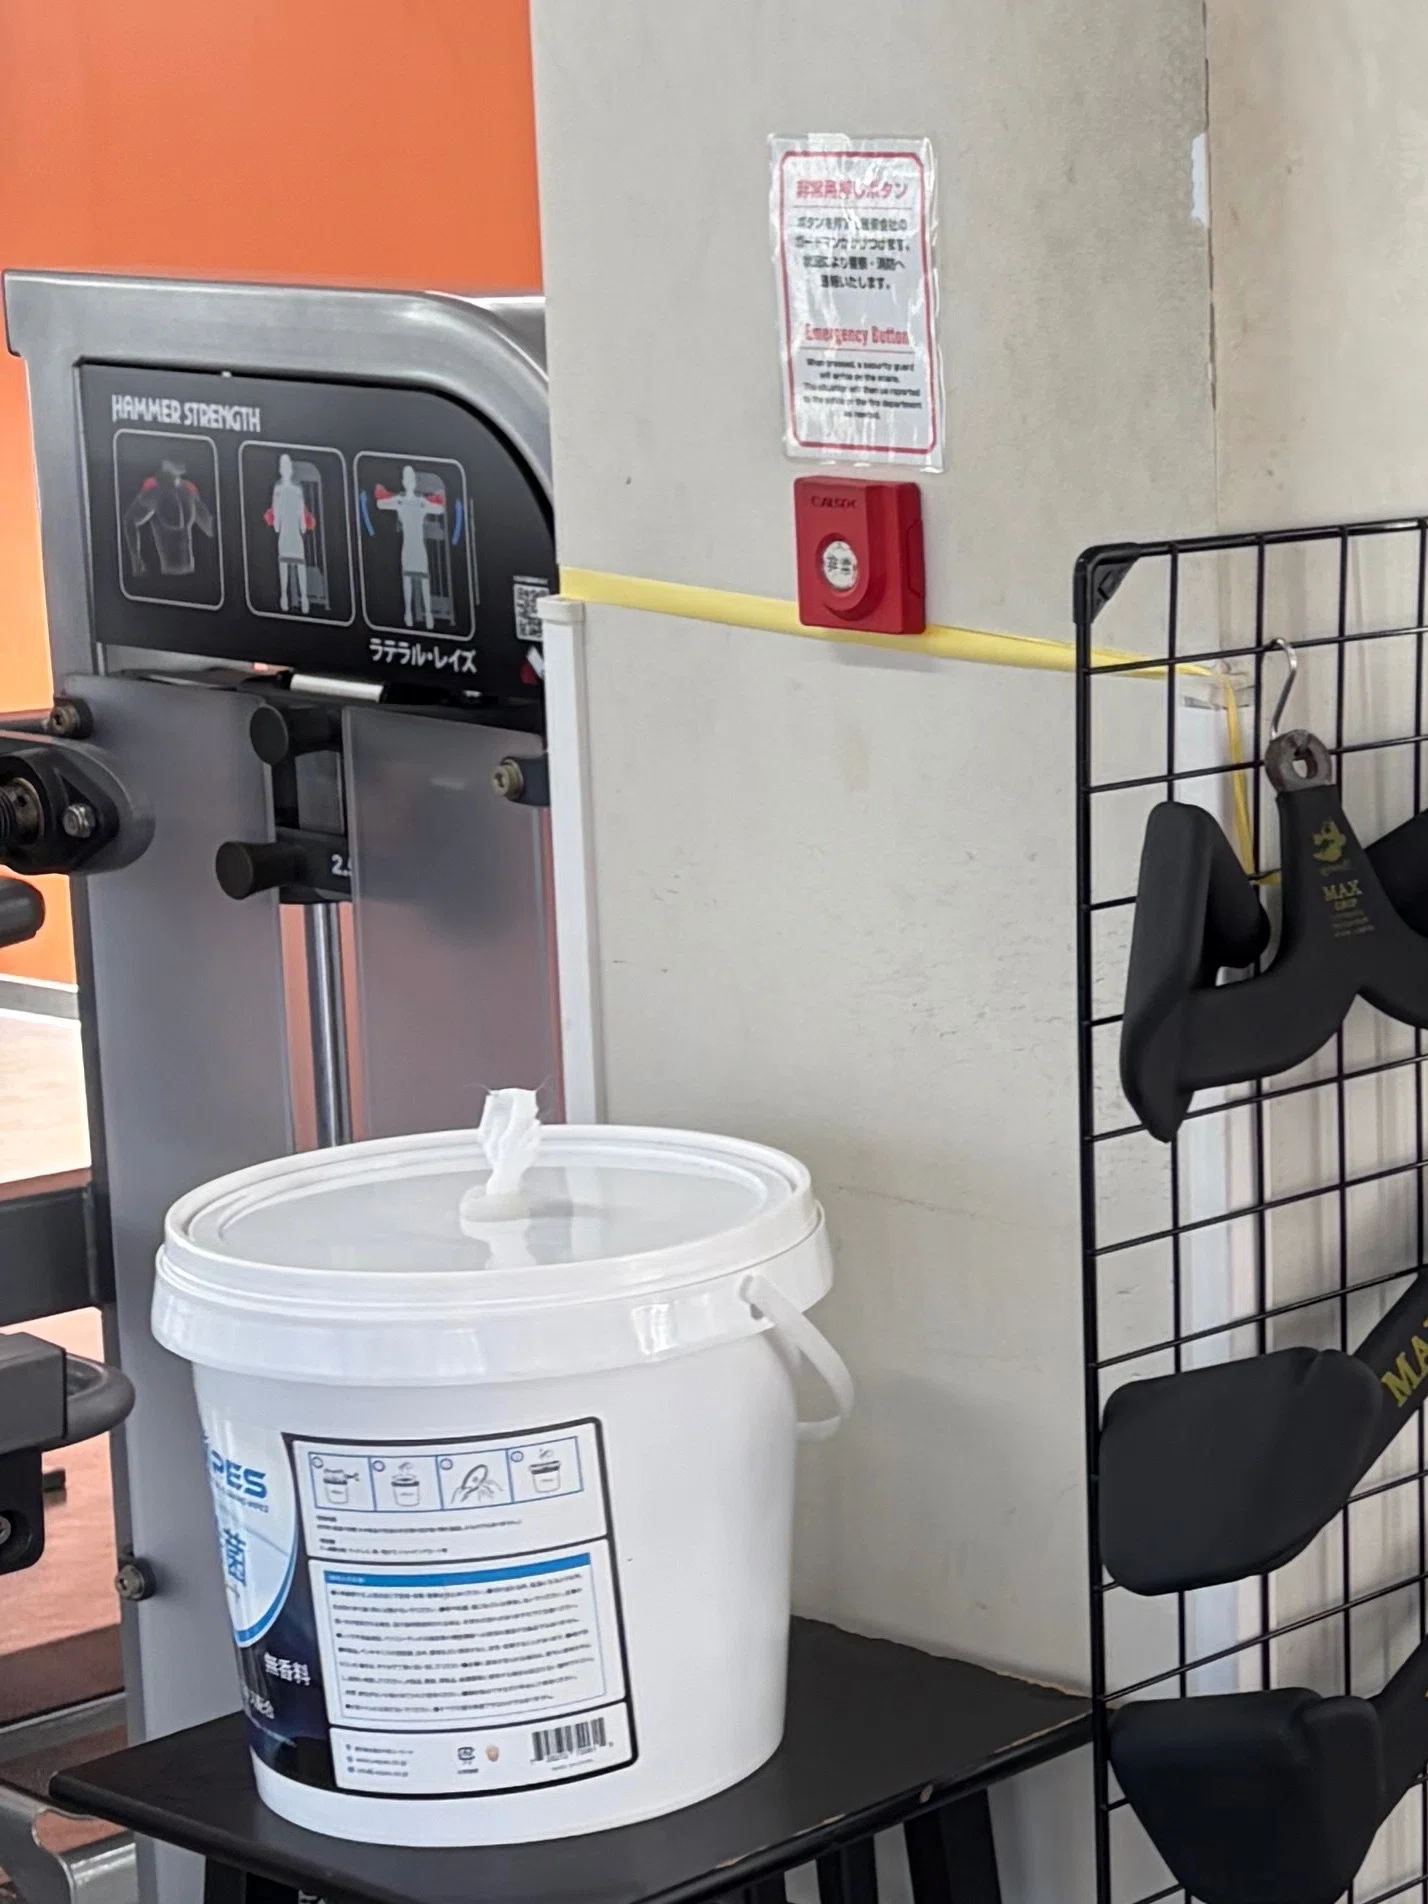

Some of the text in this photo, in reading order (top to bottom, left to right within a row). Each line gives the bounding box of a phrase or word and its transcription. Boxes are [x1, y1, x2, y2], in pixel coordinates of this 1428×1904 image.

[805, 323, 910, 346] Emergency Button
[111, 394, 262, 432] HAMMER STRENGTH
[369, 638, 477, 674] ラテラル・レイズ
[1322, 879, 1364, 902] MAX
[264, 1652, 311, 1686] 無香料
